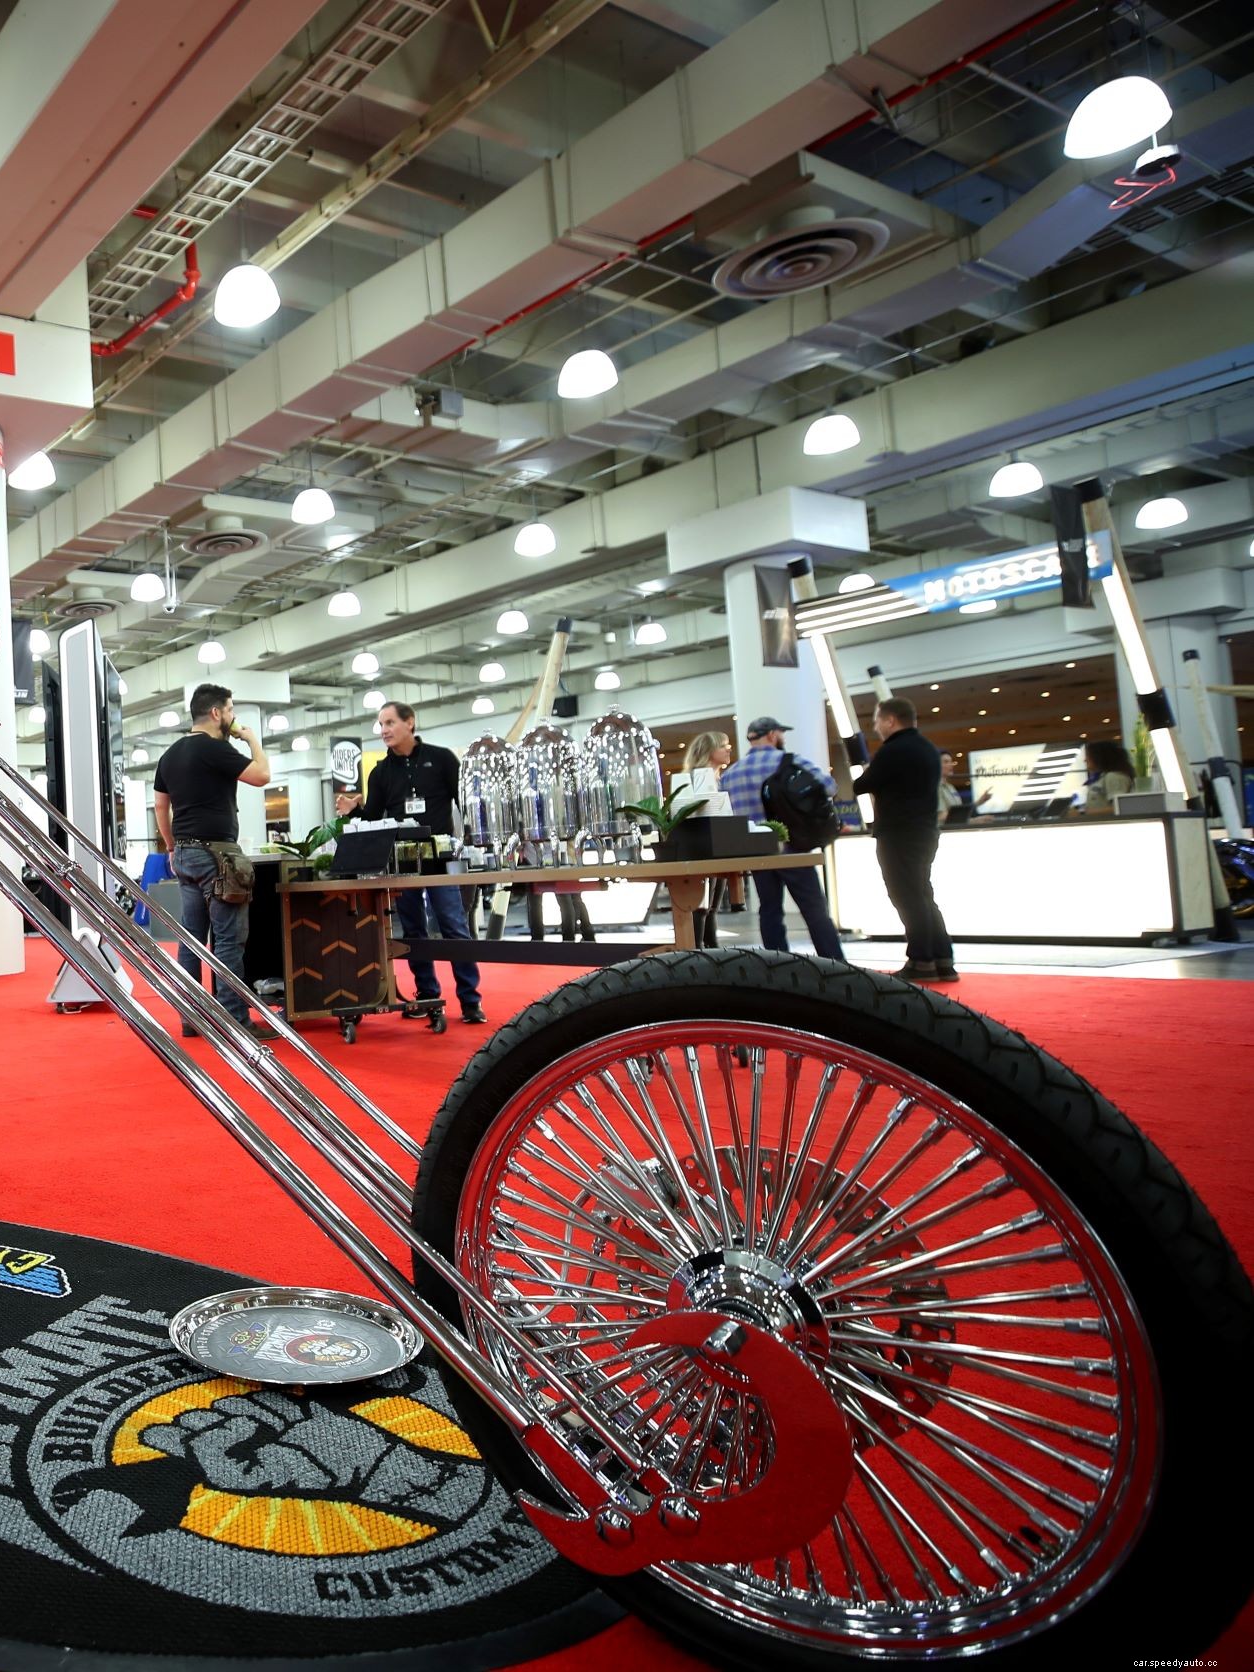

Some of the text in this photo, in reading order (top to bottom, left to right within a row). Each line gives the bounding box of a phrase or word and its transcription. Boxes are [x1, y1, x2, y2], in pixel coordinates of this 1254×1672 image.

[332, 749, 355, 762] RIDERS
[334, 759, 354, 771] UNITE
[314, 1527, 534, 1601] CUSTOM
